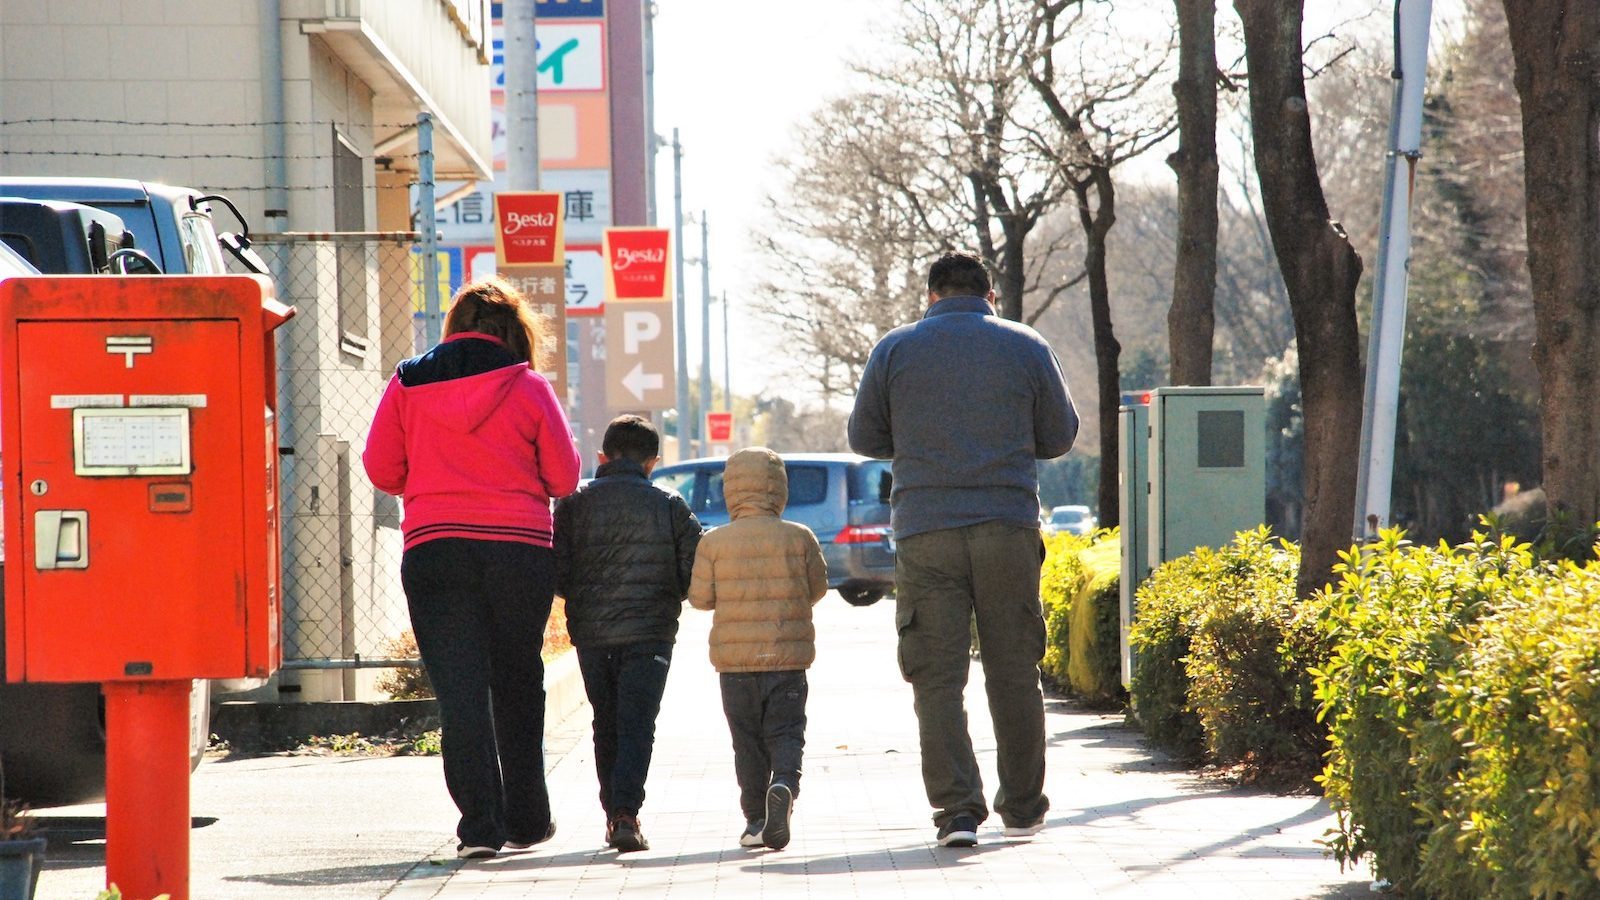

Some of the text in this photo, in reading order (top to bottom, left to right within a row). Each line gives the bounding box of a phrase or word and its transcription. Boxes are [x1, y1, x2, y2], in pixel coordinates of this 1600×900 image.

[504, 212, 555, 235] Besta
[613, 247, 665, 271] Besta
[624, 311, 661, 354] P
